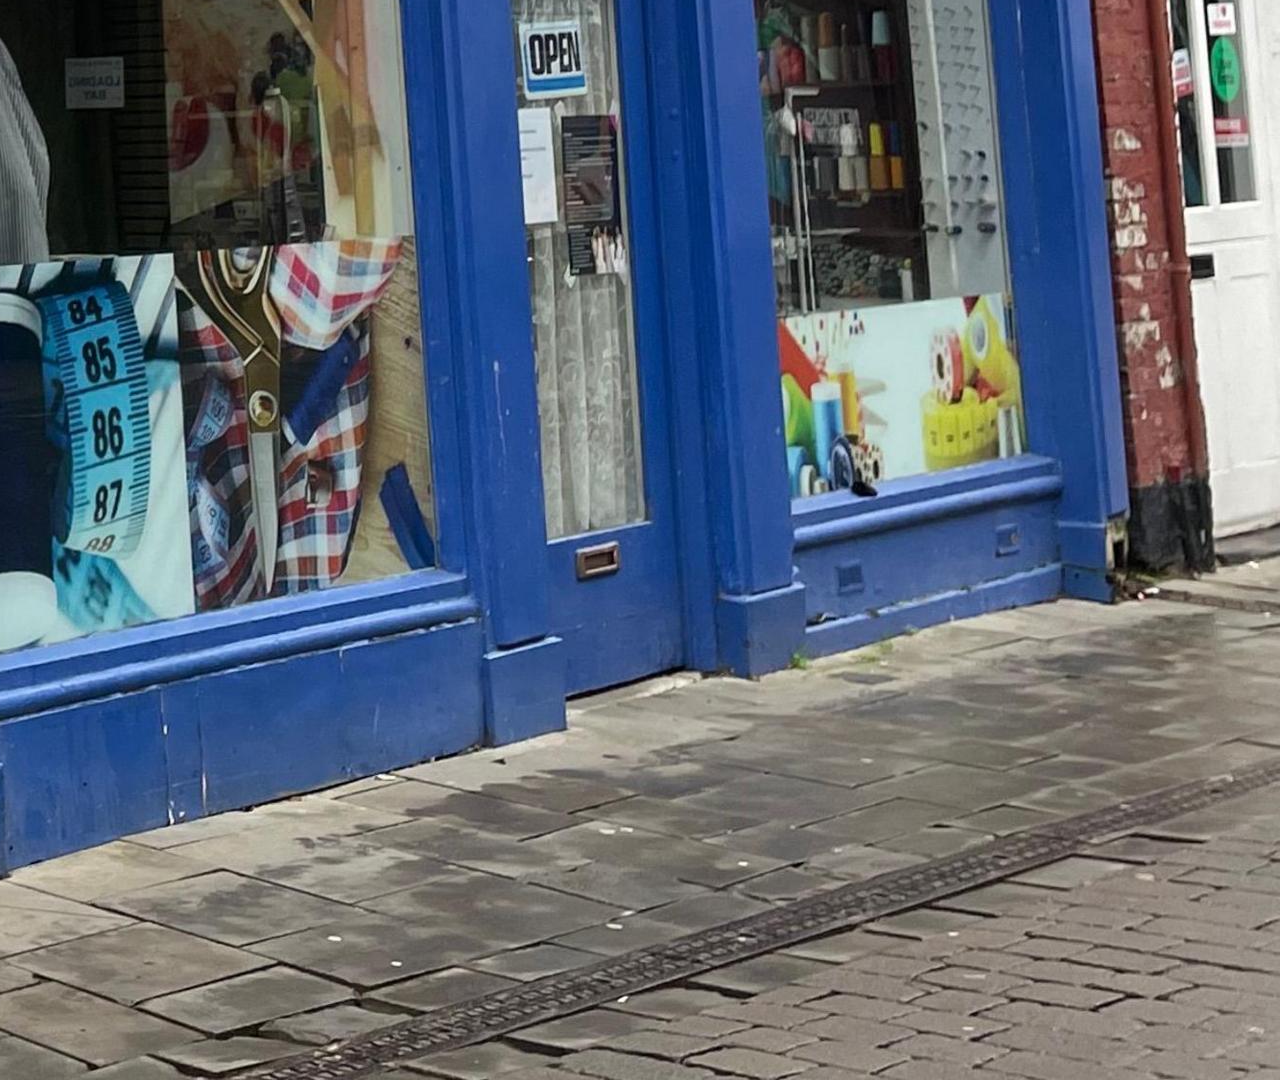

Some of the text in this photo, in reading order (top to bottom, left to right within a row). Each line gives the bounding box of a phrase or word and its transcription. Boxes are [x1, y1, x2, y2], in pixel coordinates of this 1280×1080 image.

[528, 30, 582, 76] OPEN
[67, 294, 104, 324] 84
[82, 335, 118, 385] 85
[93, 405, 125, 459] 86
[93, 478, 124, 524] 87
